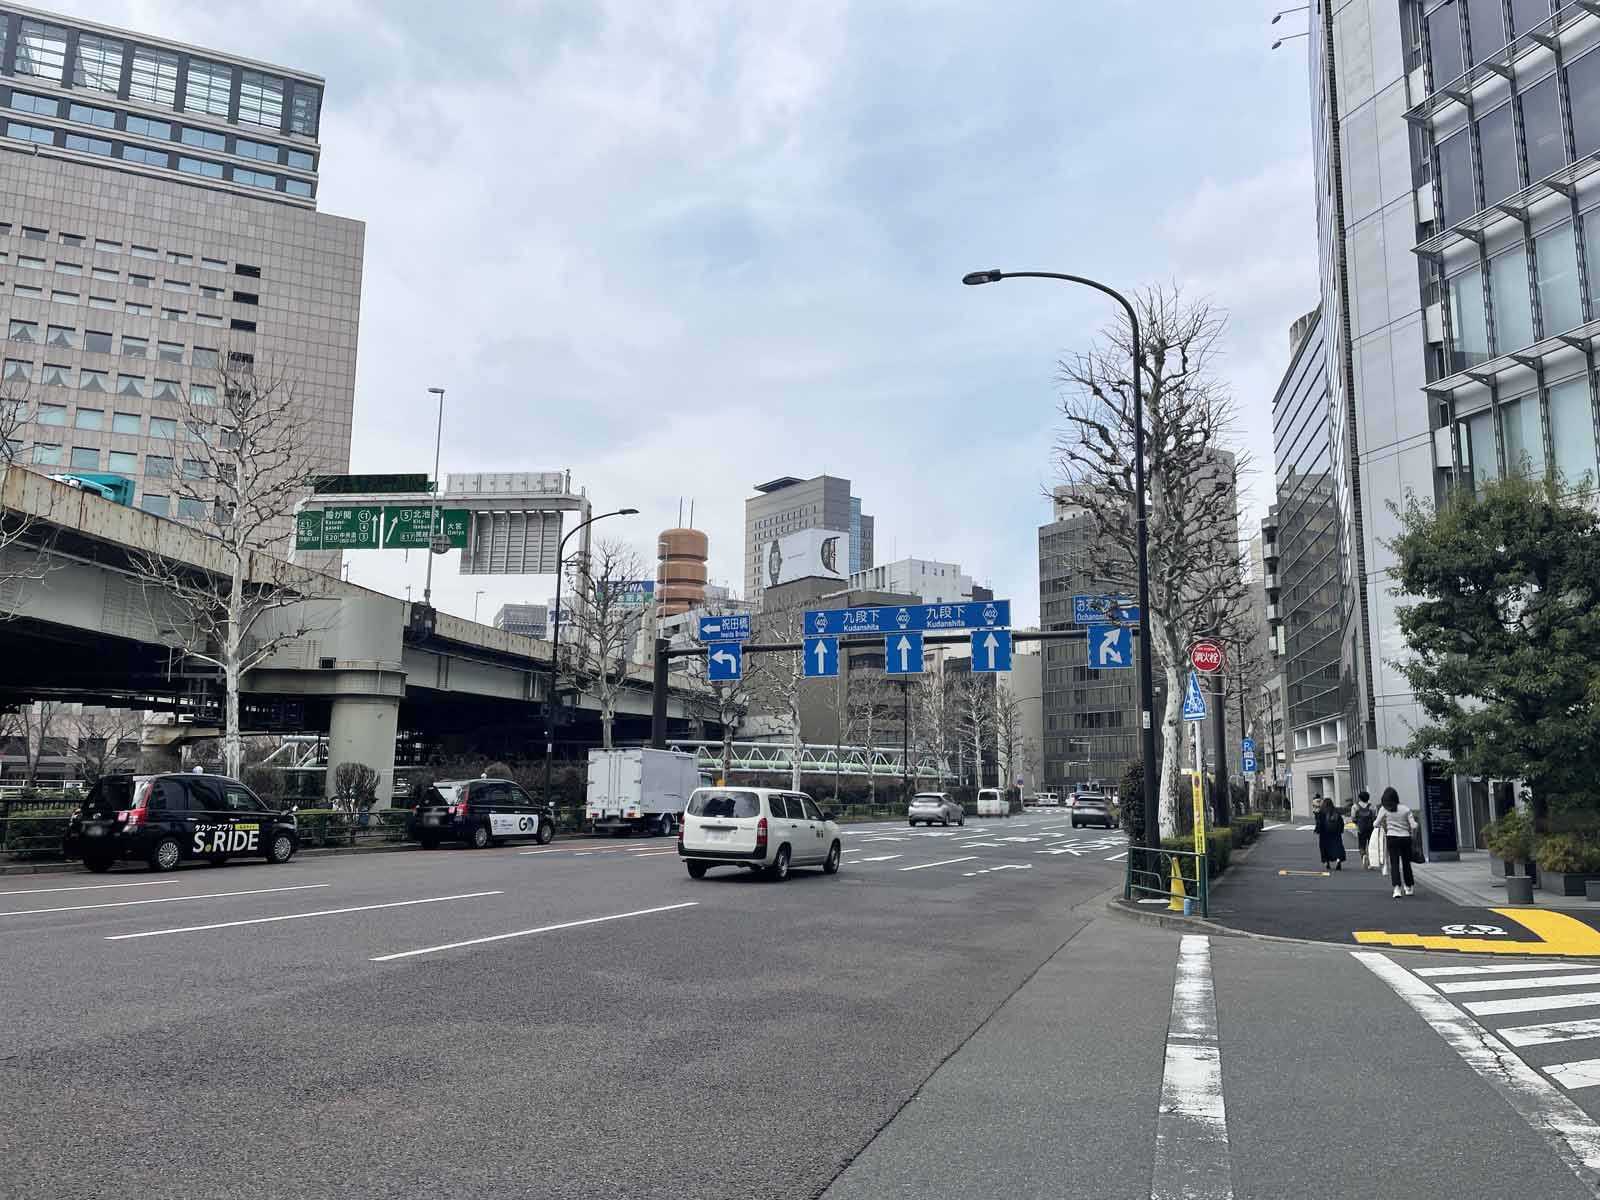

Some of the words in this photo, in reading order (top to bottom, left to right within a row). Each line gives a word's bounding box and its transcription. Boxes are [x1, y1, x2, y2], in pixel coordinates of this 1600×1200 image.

[404, 511, 410, 519] 5
[843, 609, 880, 624] 九段下
[926, 605, 965, 619] 九段下
[843, 624, 880, 632] Kudanshita
[927, 620, 966, 628] Kudanshita
[1195, 652, 1218, 663] 消火栓
[1245, 759, 1254, 771] P
[194, 823, 234, 831] タクシーアプリ
